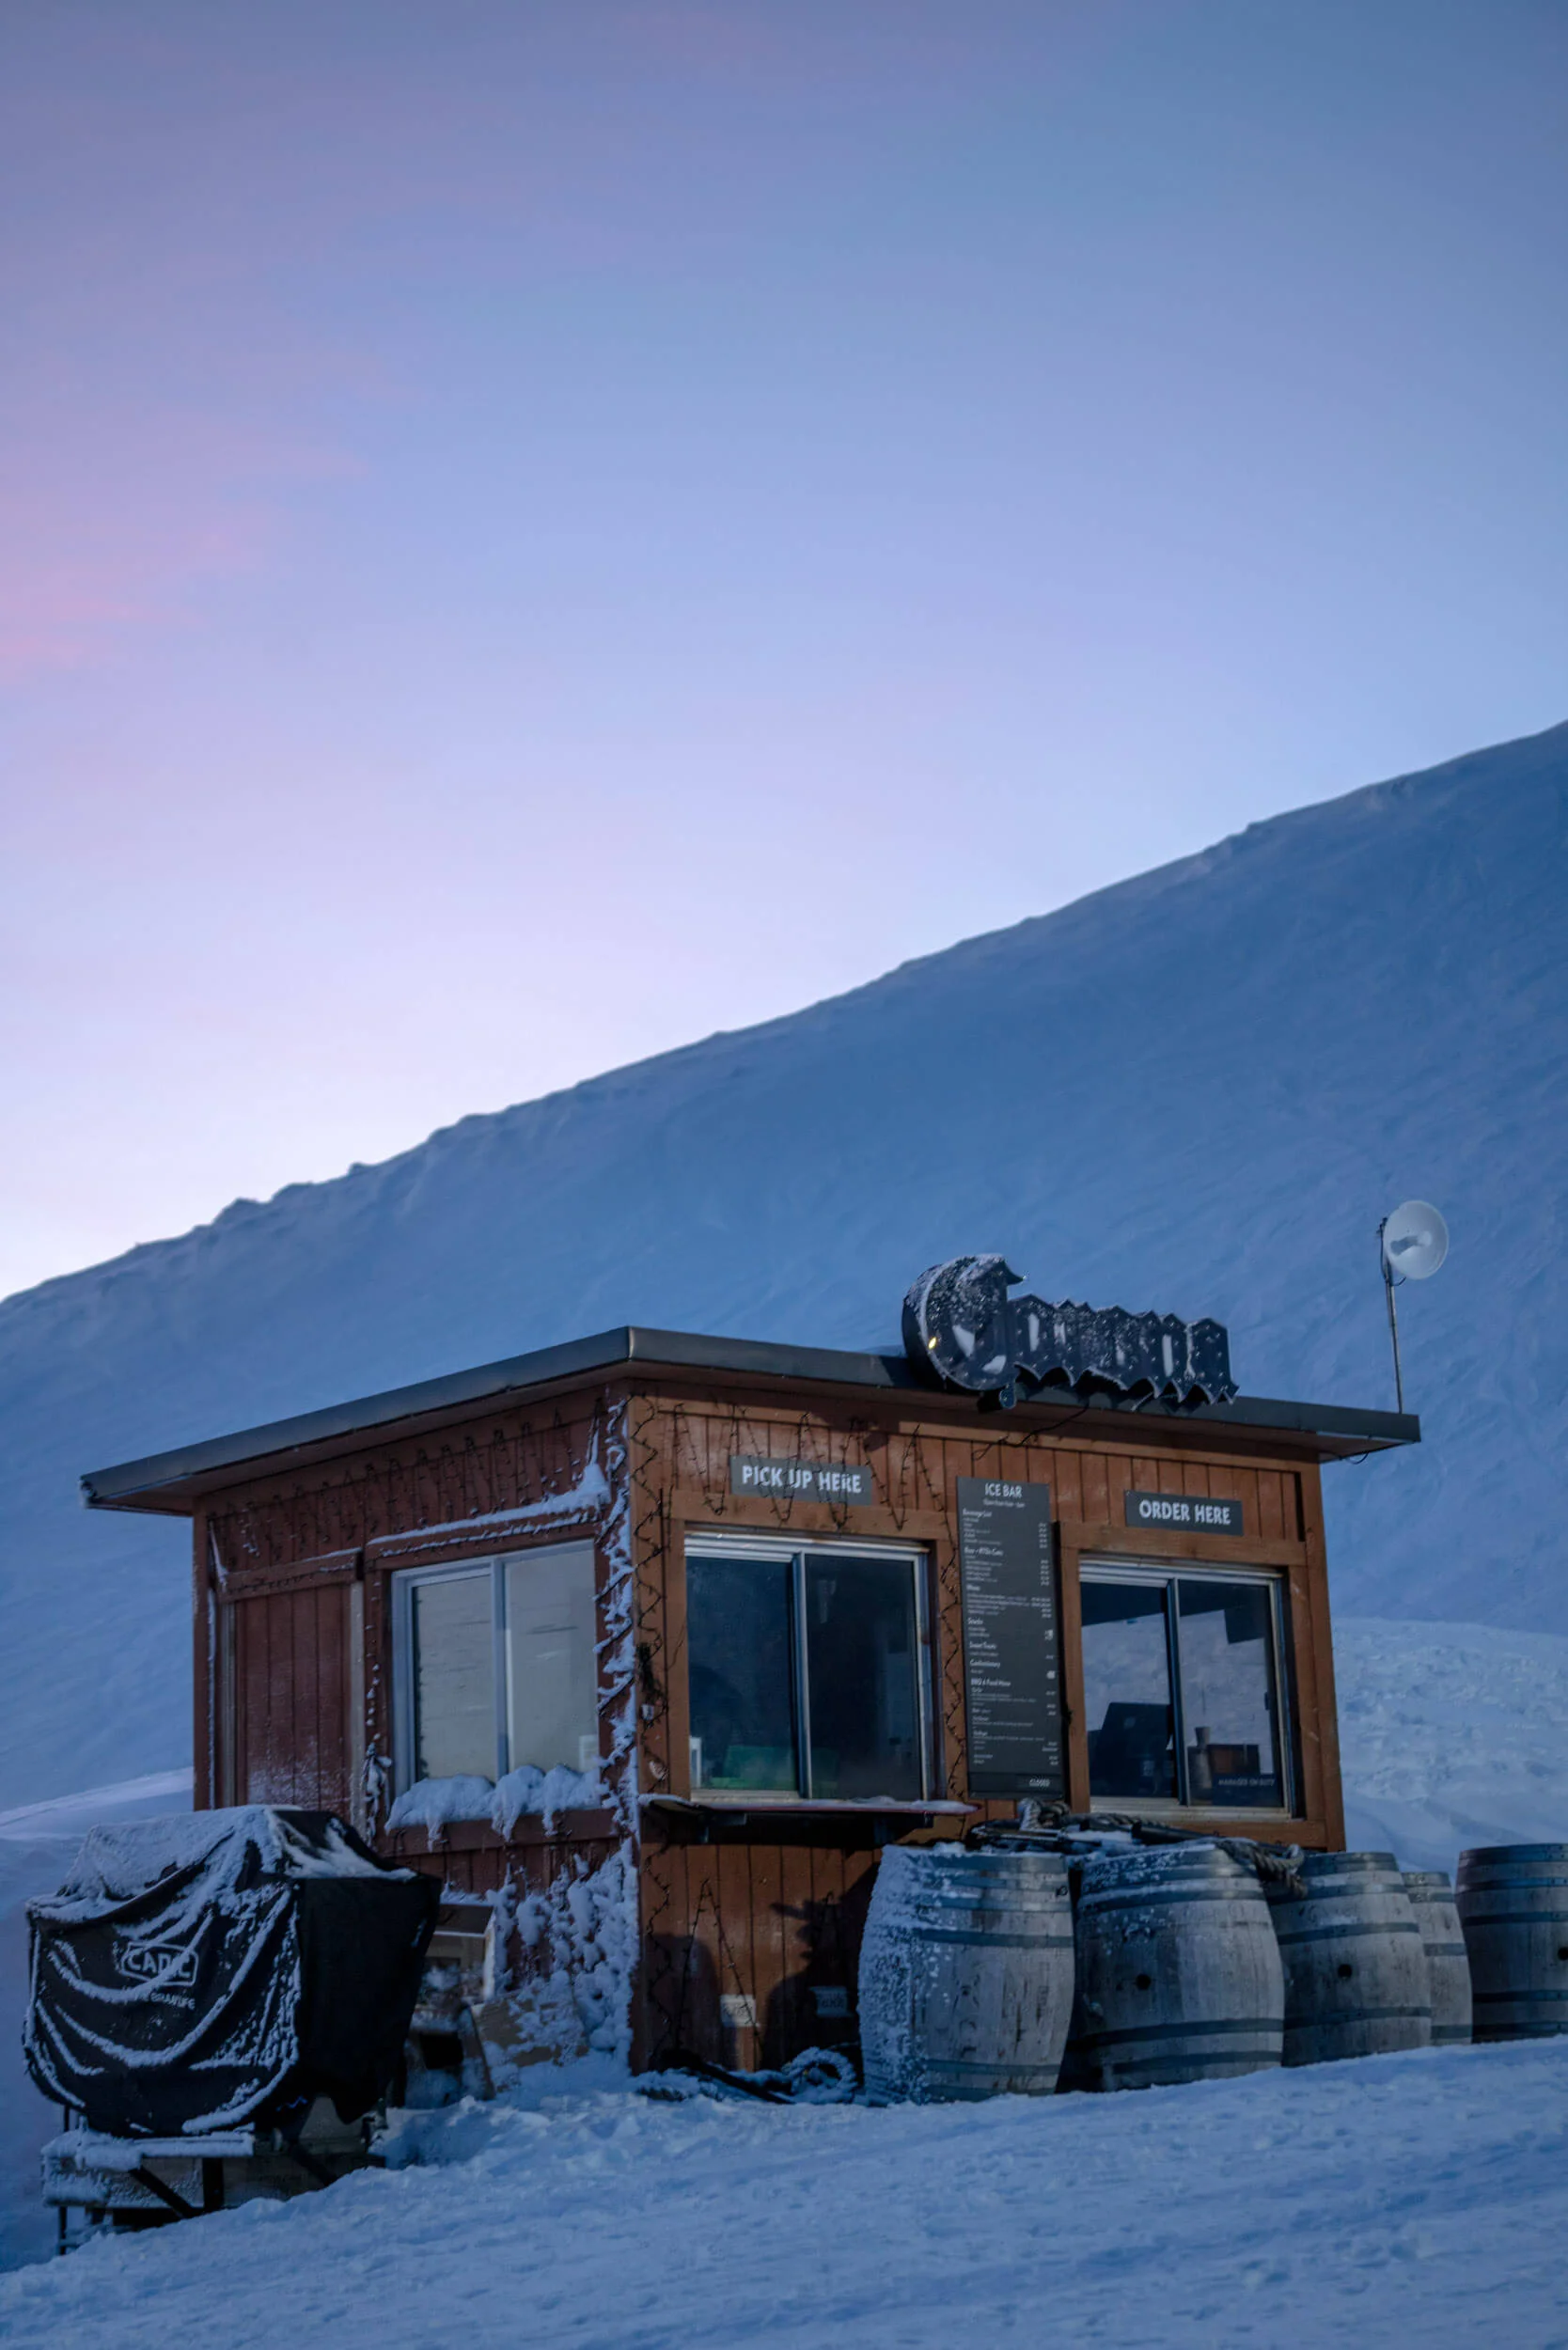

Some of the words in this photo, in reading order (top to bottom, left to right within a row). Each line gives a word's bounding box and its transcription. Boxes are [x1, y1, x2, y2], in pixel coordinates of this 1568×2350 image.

[742, 1465, 783, 1487] PICK
[788, 1468, 813, 1489] UP
[819, 1471, 862, 1494] HERE
[984, 1482, 1001, 1496] ICE
[1002, 1484, 1023, 1498] BAR
[1138, 1499, 1190, 1522] ORDER
[1194, 1504, 1231, 1525] HERE
